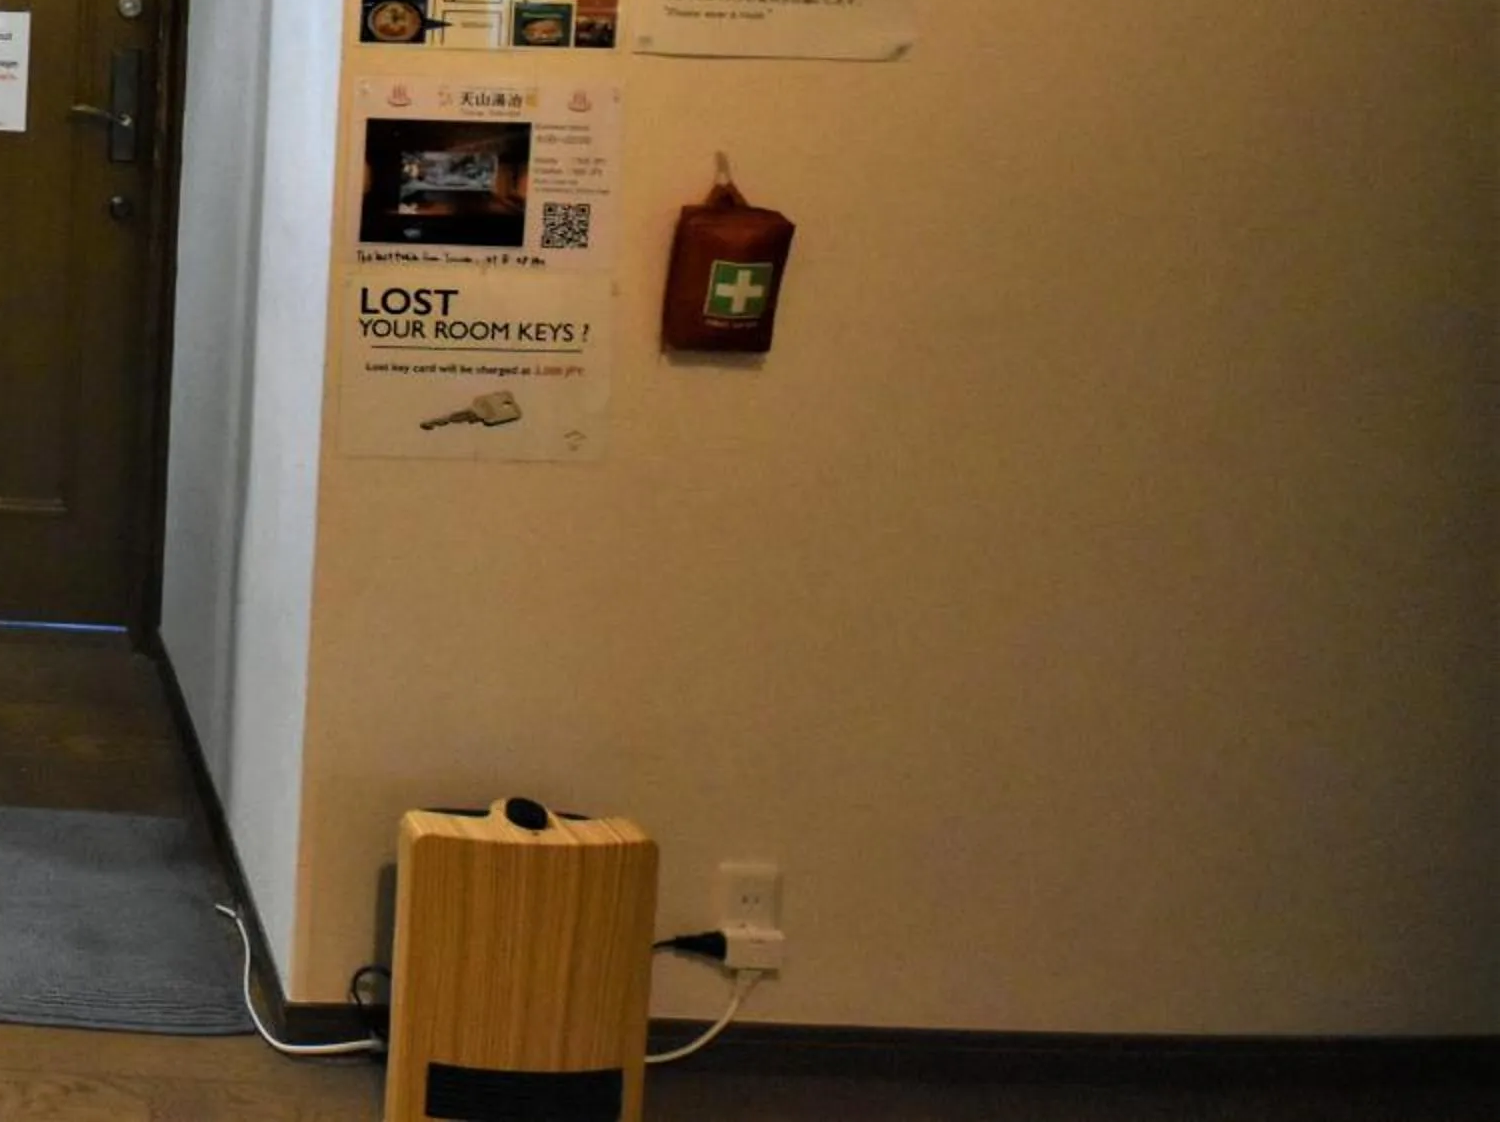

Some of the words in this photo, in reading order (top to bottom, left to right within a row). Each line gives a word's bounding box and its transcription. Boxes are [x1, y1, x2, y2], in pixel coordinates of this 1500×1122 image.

[360, 287, 459, 316] LOST
[359, 318, 426, 340] YOUR
[434, 320, 510, 341] ROOM
[517, 322, 575, 343] KEYS
[365, 362, 389, 373] Lost
[391, 363, 409, 375] key
[413, 363, 436, 374] card
[438, 363, 457, 374] will
[460, 364, 473, 374] be
[475, 364, 518, 377] charged
